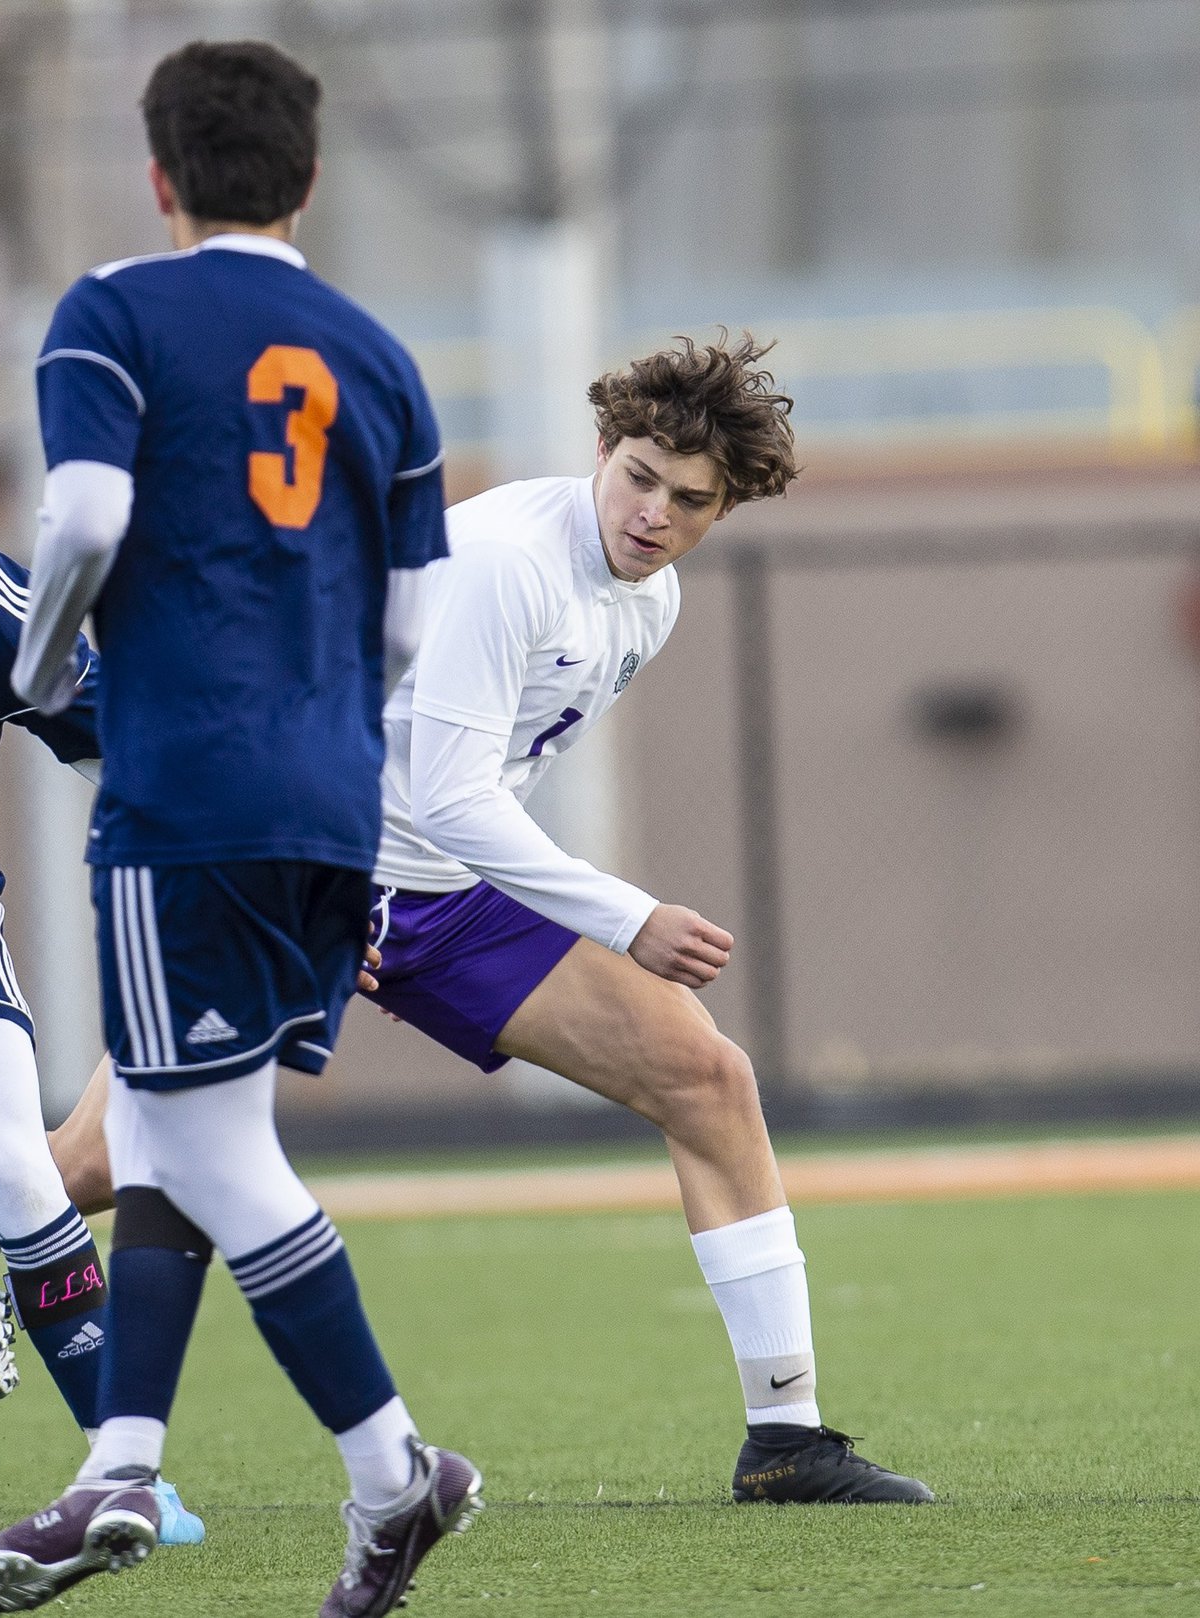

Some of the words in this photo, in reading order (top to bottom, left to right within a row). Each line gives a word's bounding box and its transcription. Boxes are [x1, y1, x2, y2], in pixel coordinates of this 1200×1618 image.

[246, 344, 339, 530] 3
[39, 1263, 103, 1308] LLA
[742, 1464, 796, 1485] NEMESIS
